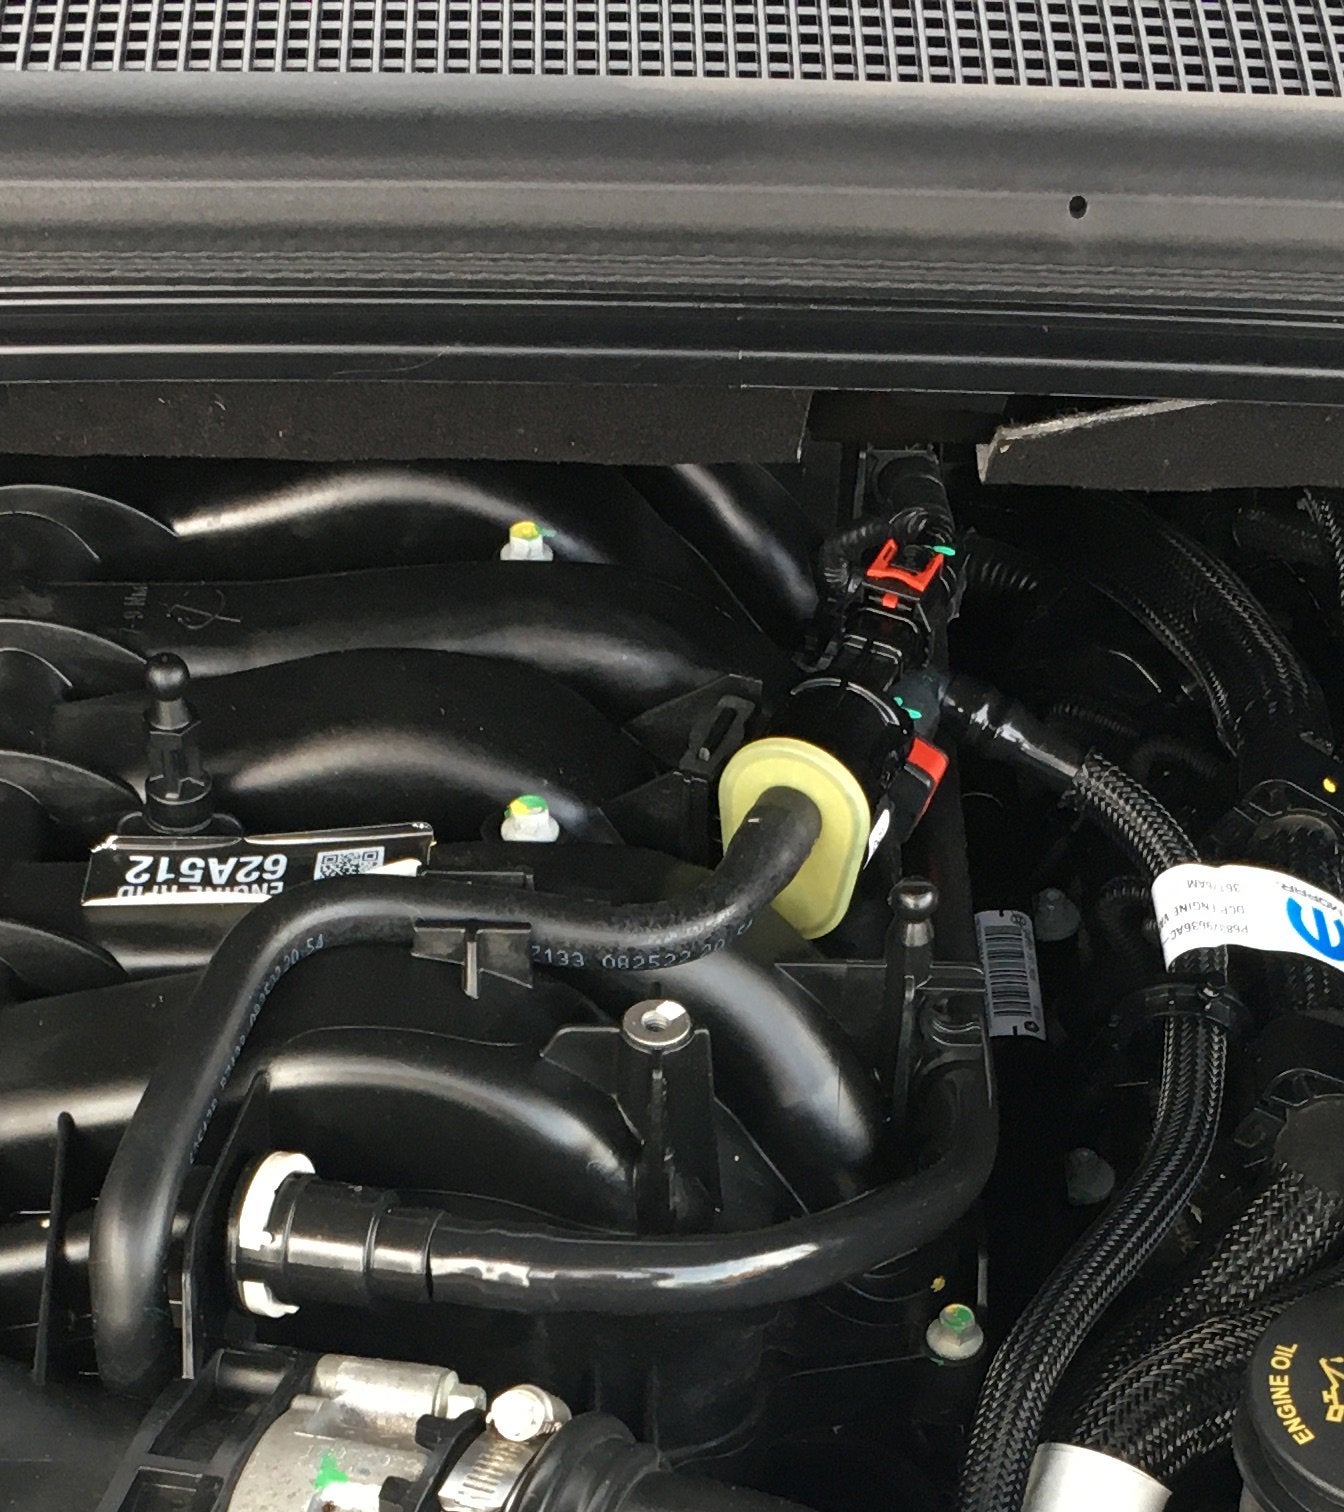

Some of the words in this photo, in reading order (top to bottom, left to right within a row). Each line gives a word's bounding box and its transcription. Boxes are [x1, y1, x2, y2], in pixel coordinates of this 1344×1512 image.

[124, 853, 288, 884] 62A512
[1270, 1343, 1299, 1371] OIL
[1268, 1374, 1315, 1446] ENGINE
